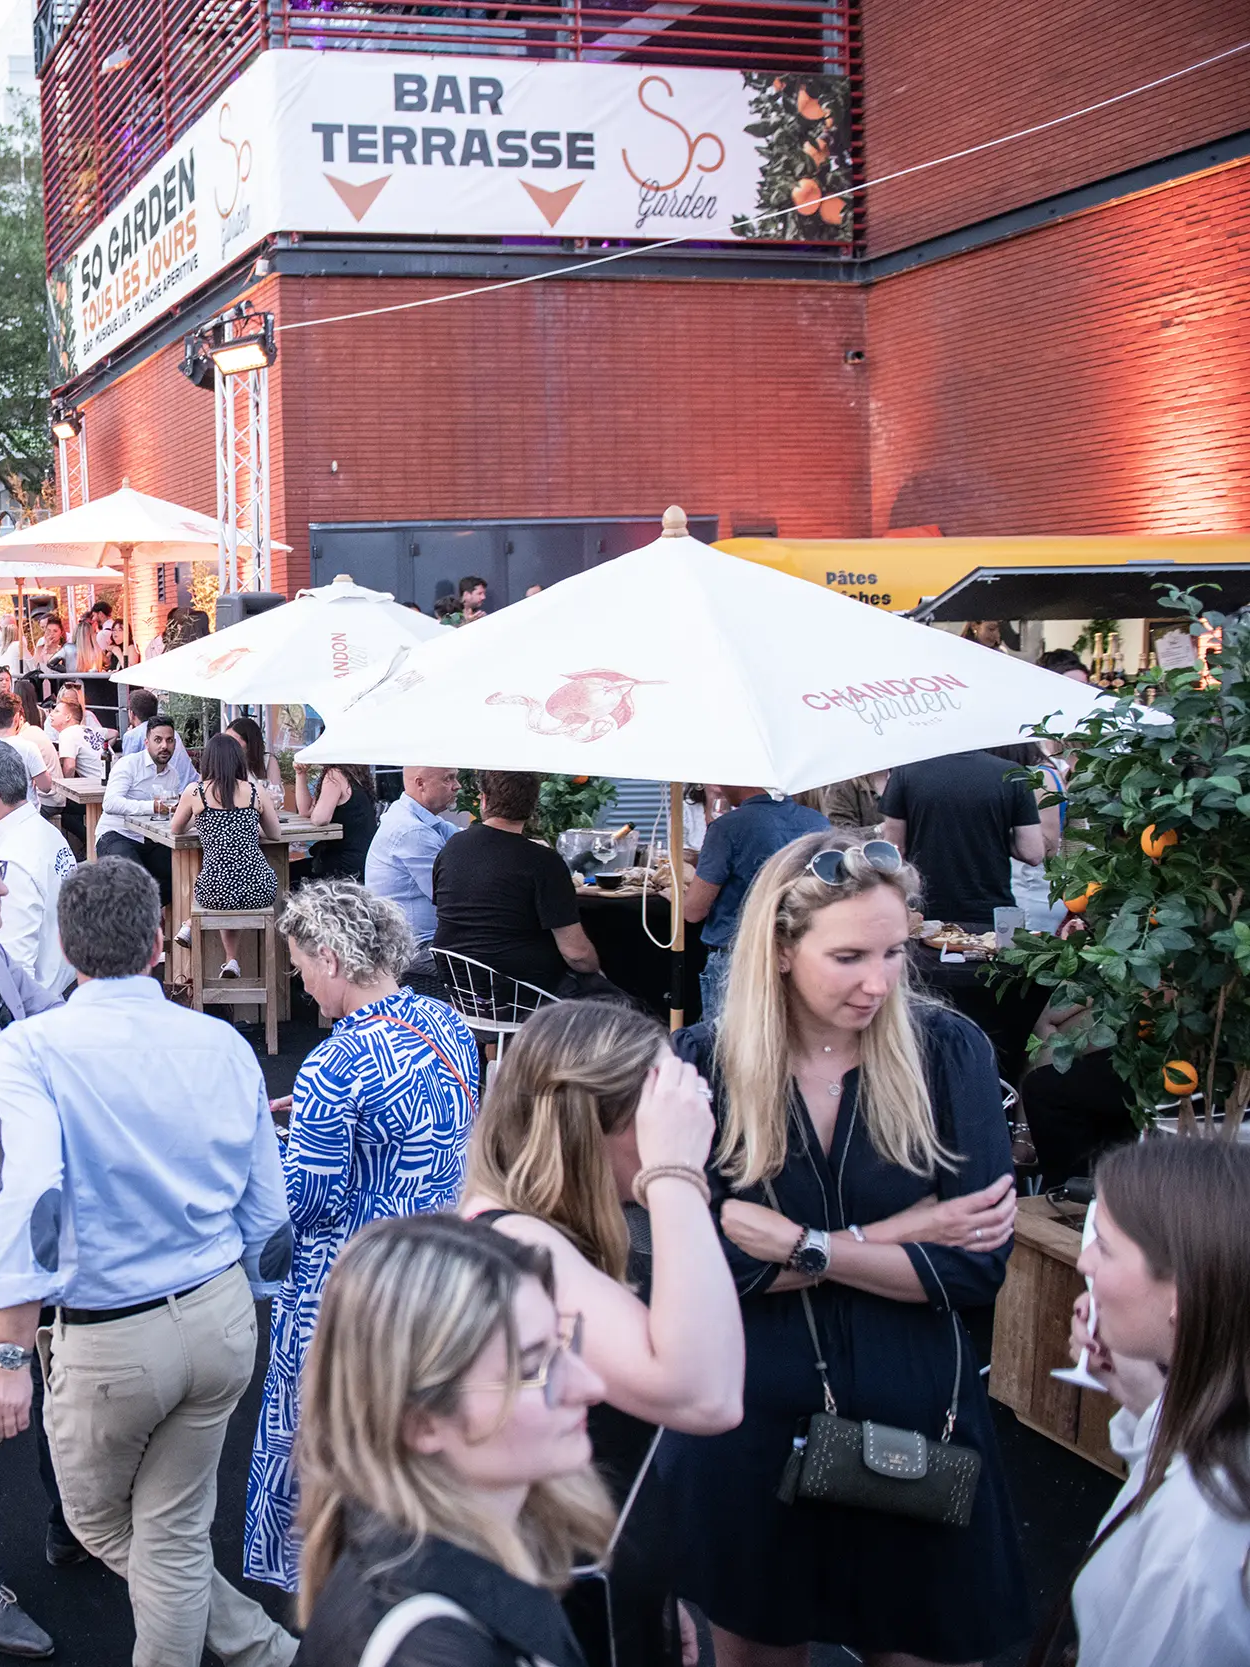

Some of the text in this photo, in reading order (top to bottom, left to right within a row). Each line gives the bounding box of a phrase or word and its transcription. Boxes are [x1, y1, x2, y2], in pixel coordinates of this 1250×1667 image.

[393, 72, 504, 116] BAR
[312, 122, 595, 170] TERRASSE
[81, 147, 196, 303] SO GARDEN
[635, 175, 718, 229] Garden
[82, 209, 198, 337] TOUS LES JOURS
[134, 283, 162, 316] PLANCHE
[826, 570, 878, 585] Pâtes
[801, 674, 970, 711] CHANDON
[840, 679, 962, 736] Garden
